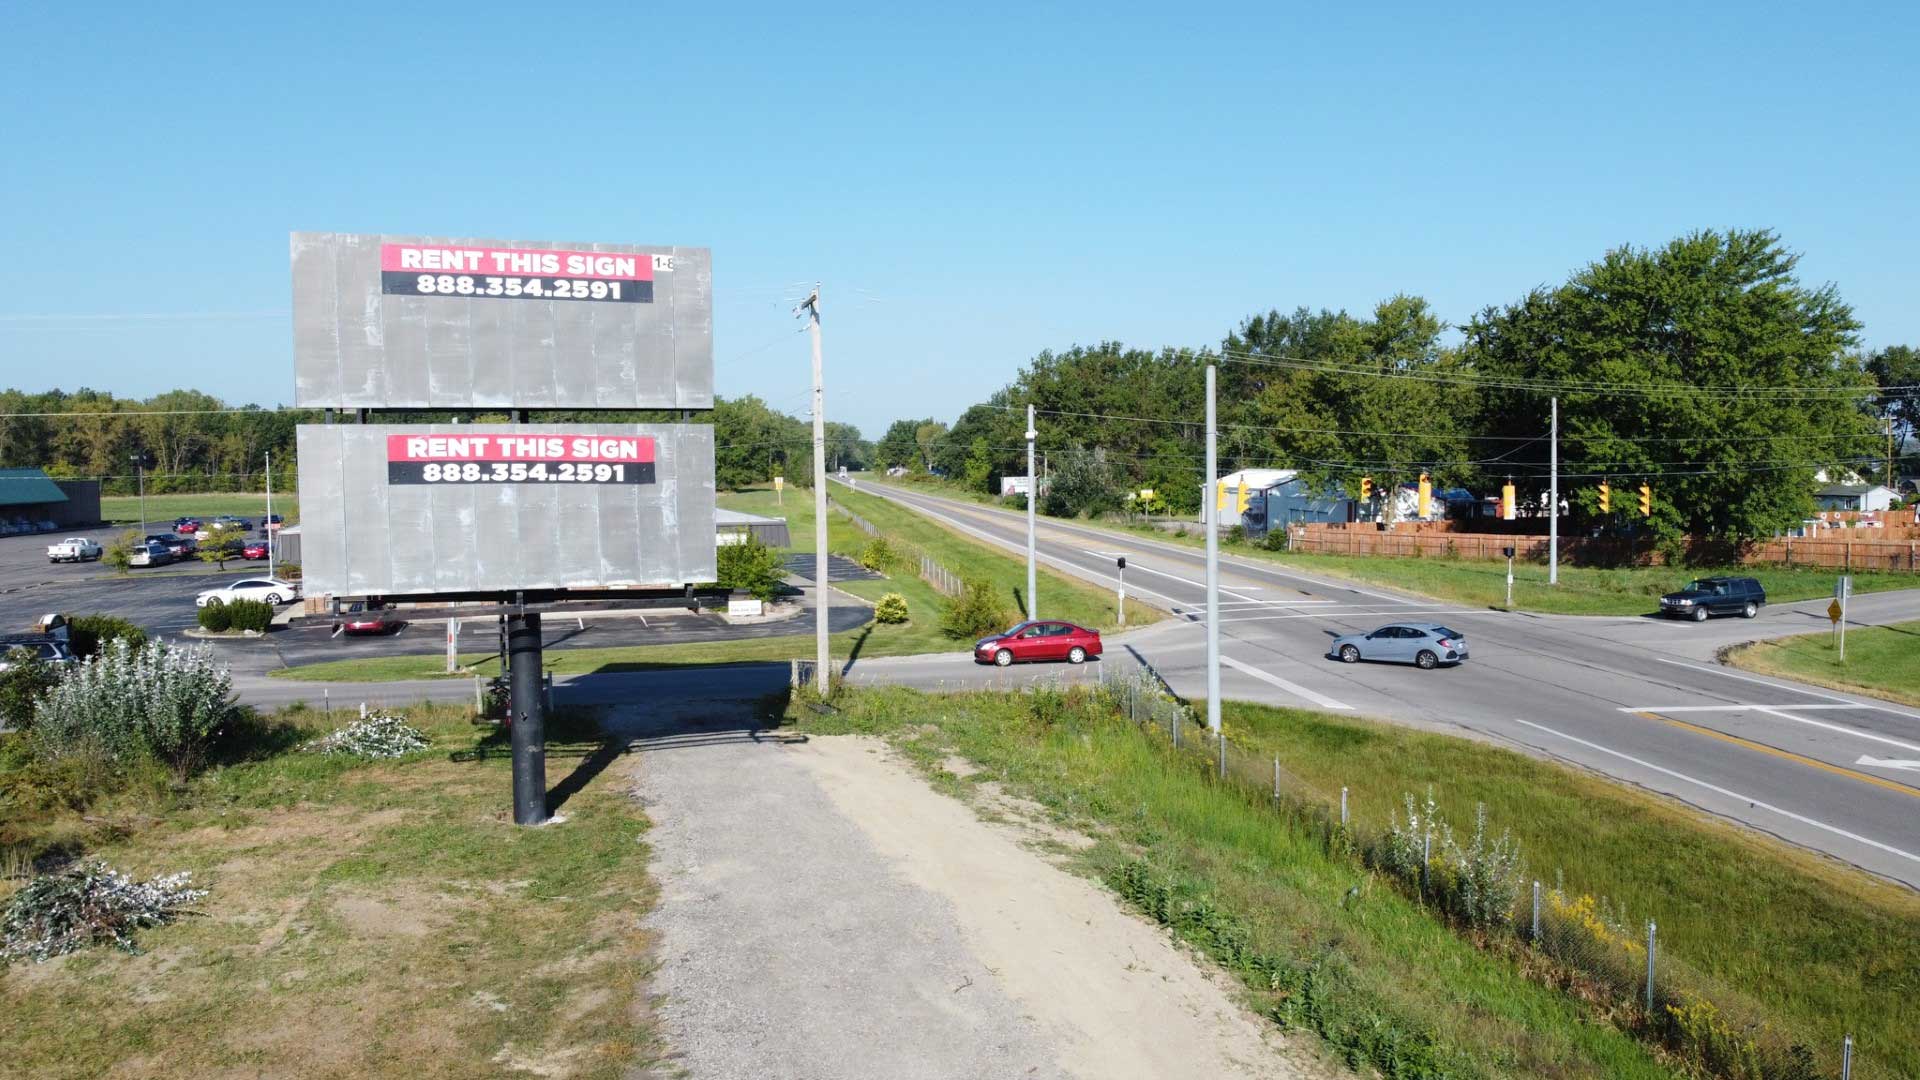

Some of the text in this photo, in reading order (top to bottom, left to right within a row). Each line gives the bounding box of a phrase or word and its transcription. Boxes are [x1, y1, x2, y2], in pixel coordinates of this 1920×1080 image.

[400, 248, 636, 277] RENT THIS SIGN
[416, 274, 621, 299] 888.354.2591
[407, 437, 638, 459] RENT THIS SIGN
[423, 463, 625, 482] 888.354.2591
